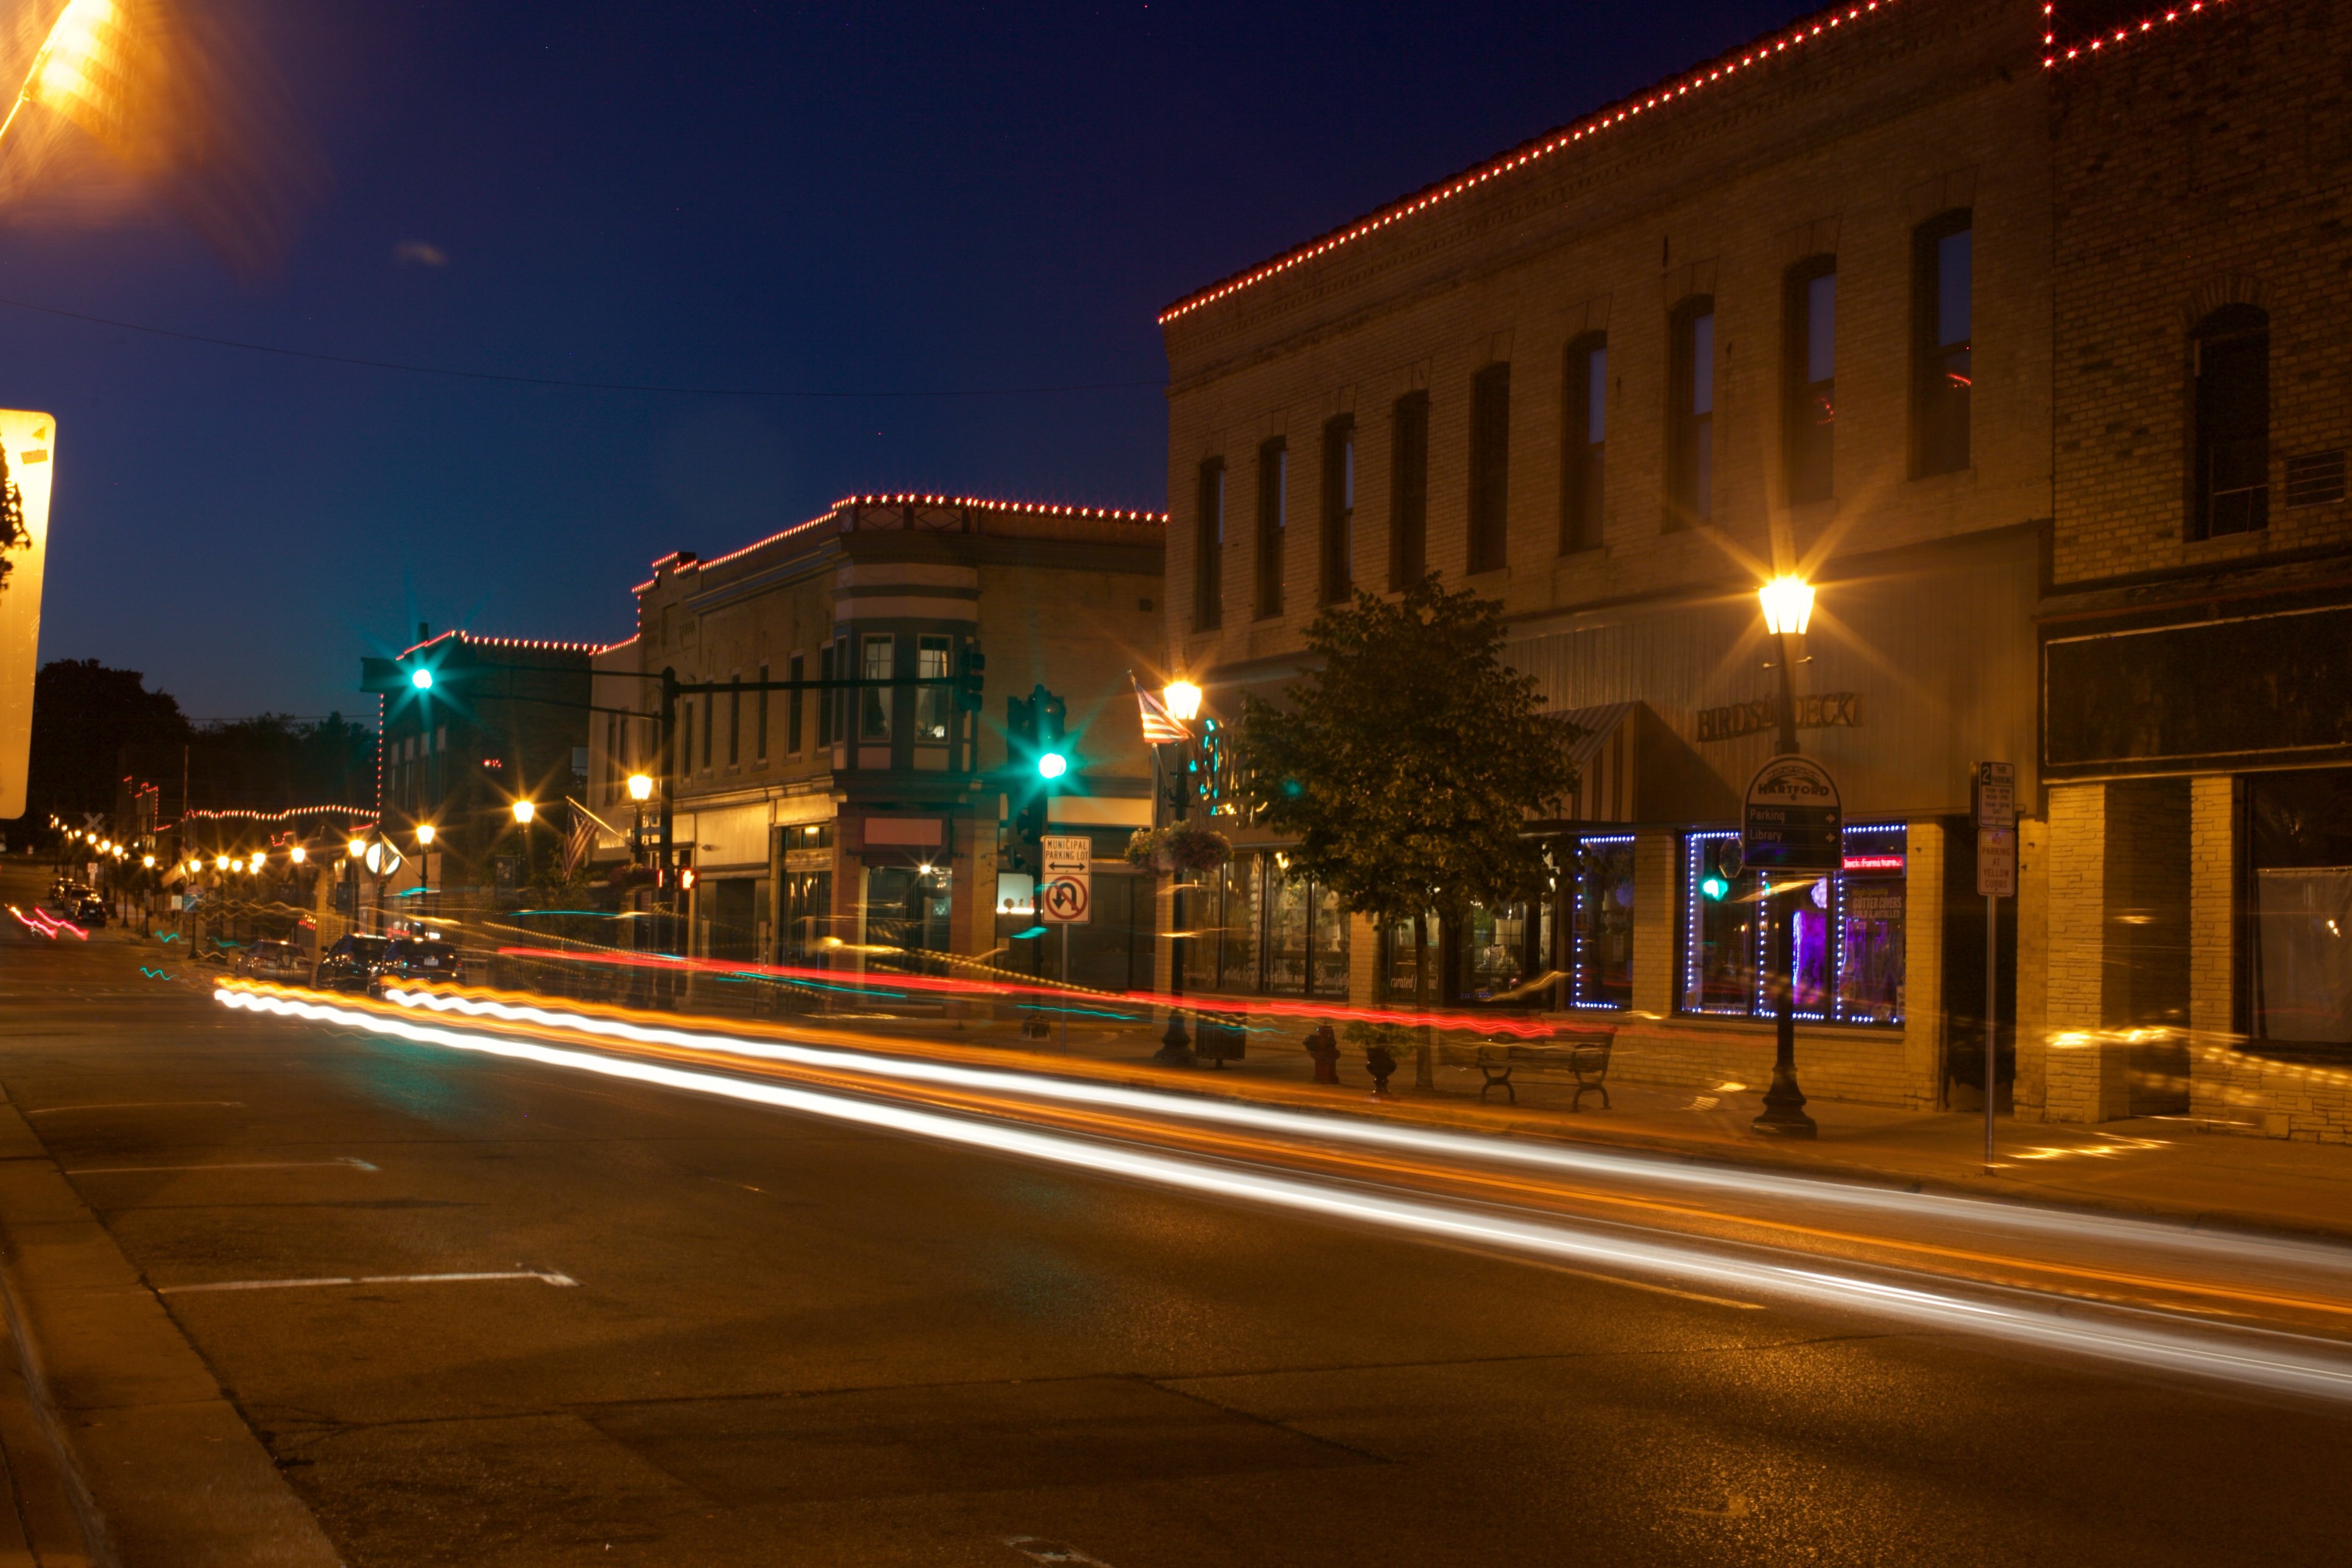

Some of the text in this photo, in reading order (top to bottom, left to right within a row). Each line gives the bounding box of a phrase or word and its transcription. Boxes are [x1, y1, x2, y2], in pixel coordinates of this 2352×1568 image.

[1982, 766, 1990, 782] 2
[1991, 775, 2013, 785] PARKING
[1758, 783, 1829, 796] HARTFORD
[1750, 809, 1785, 824] Parking
[1750, 828, 1782, 842] Library
[1047, 840, 1087, 850] MUNICIPAL
[1045, 850, 1089, 860] PARKING LOT
[1982, 847, 2010, 856] PARKING
[1983, 869, 2009, 877] YELLOW
[1985, 880, 2007, 888] CURBS
[1852, 896, 1902, 909] GUTTER COVERS
[1390, 975, 1414, 989] curated
